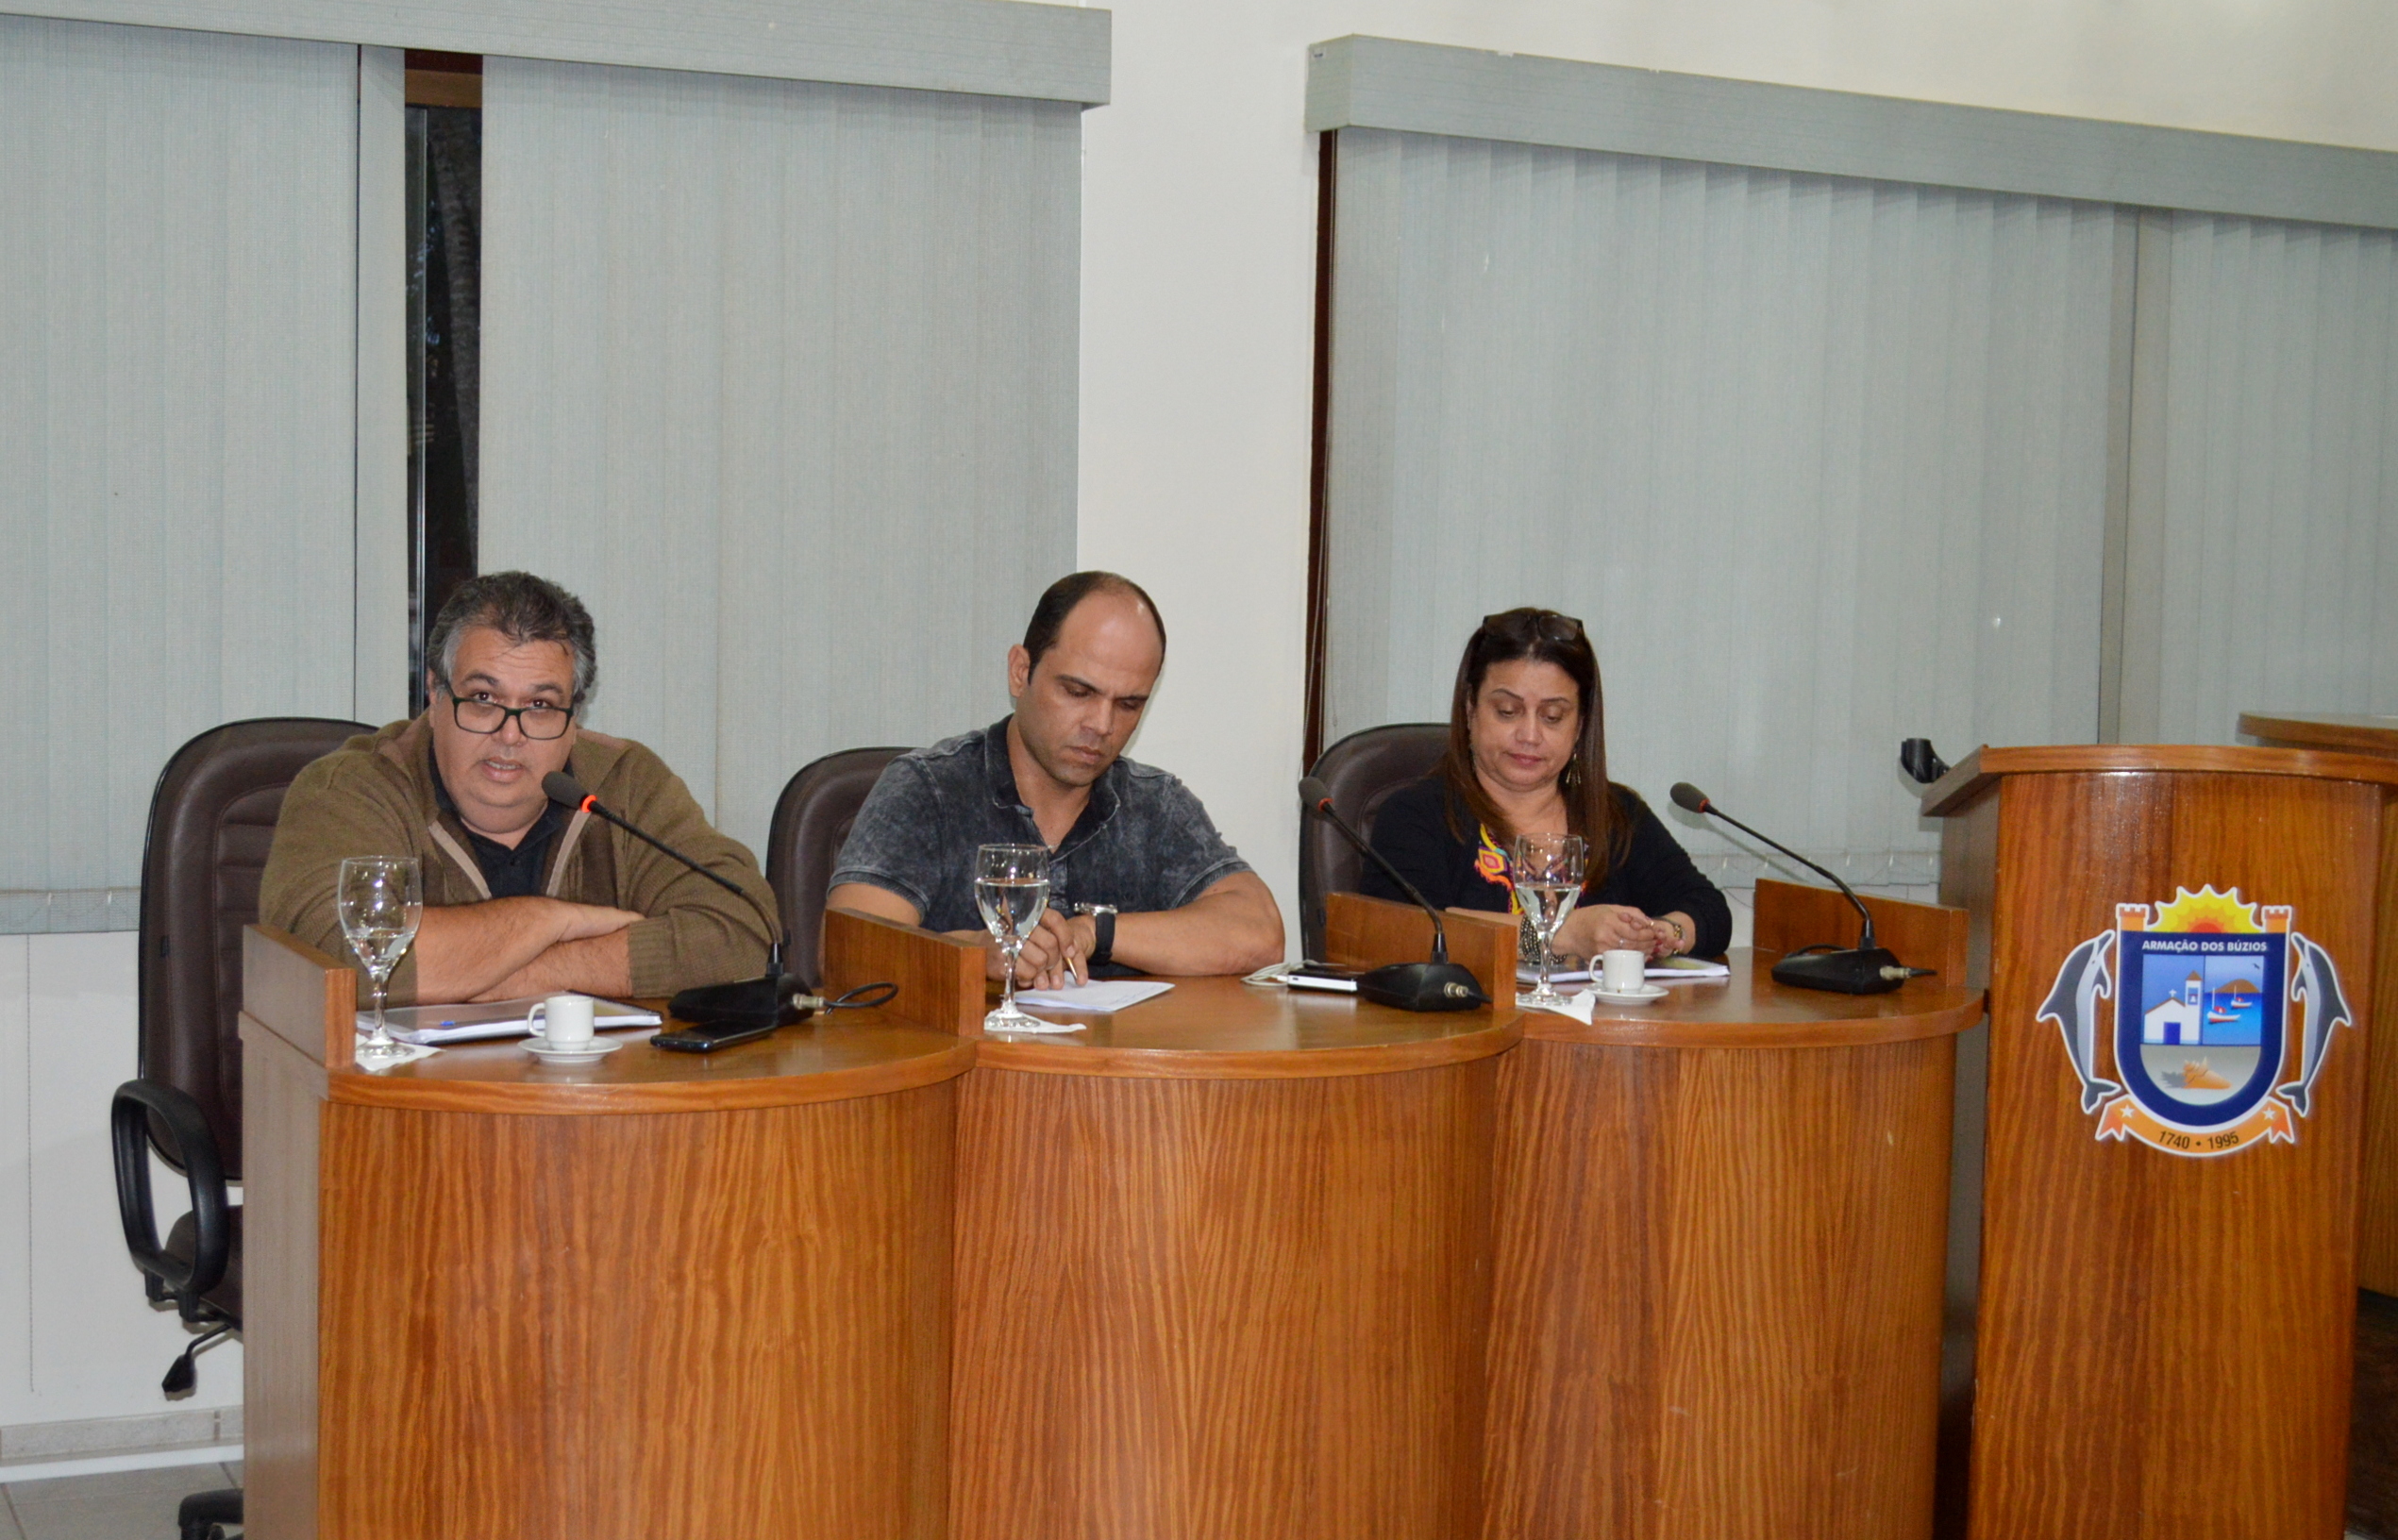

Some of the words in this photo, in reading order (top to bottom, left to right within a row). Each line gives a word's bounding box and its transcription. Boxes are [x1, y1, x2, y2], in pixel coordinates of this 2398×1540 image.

[2142, 939, 2198, 953] ARMAÇÃO
[2201, 942, 2224, 951] DOS
[2227, 940, 2267, 952] BÚZIOS
[2159, 1131, 2190, 1149] 1740
[2207, 1131, 2239, 1149] 1995
